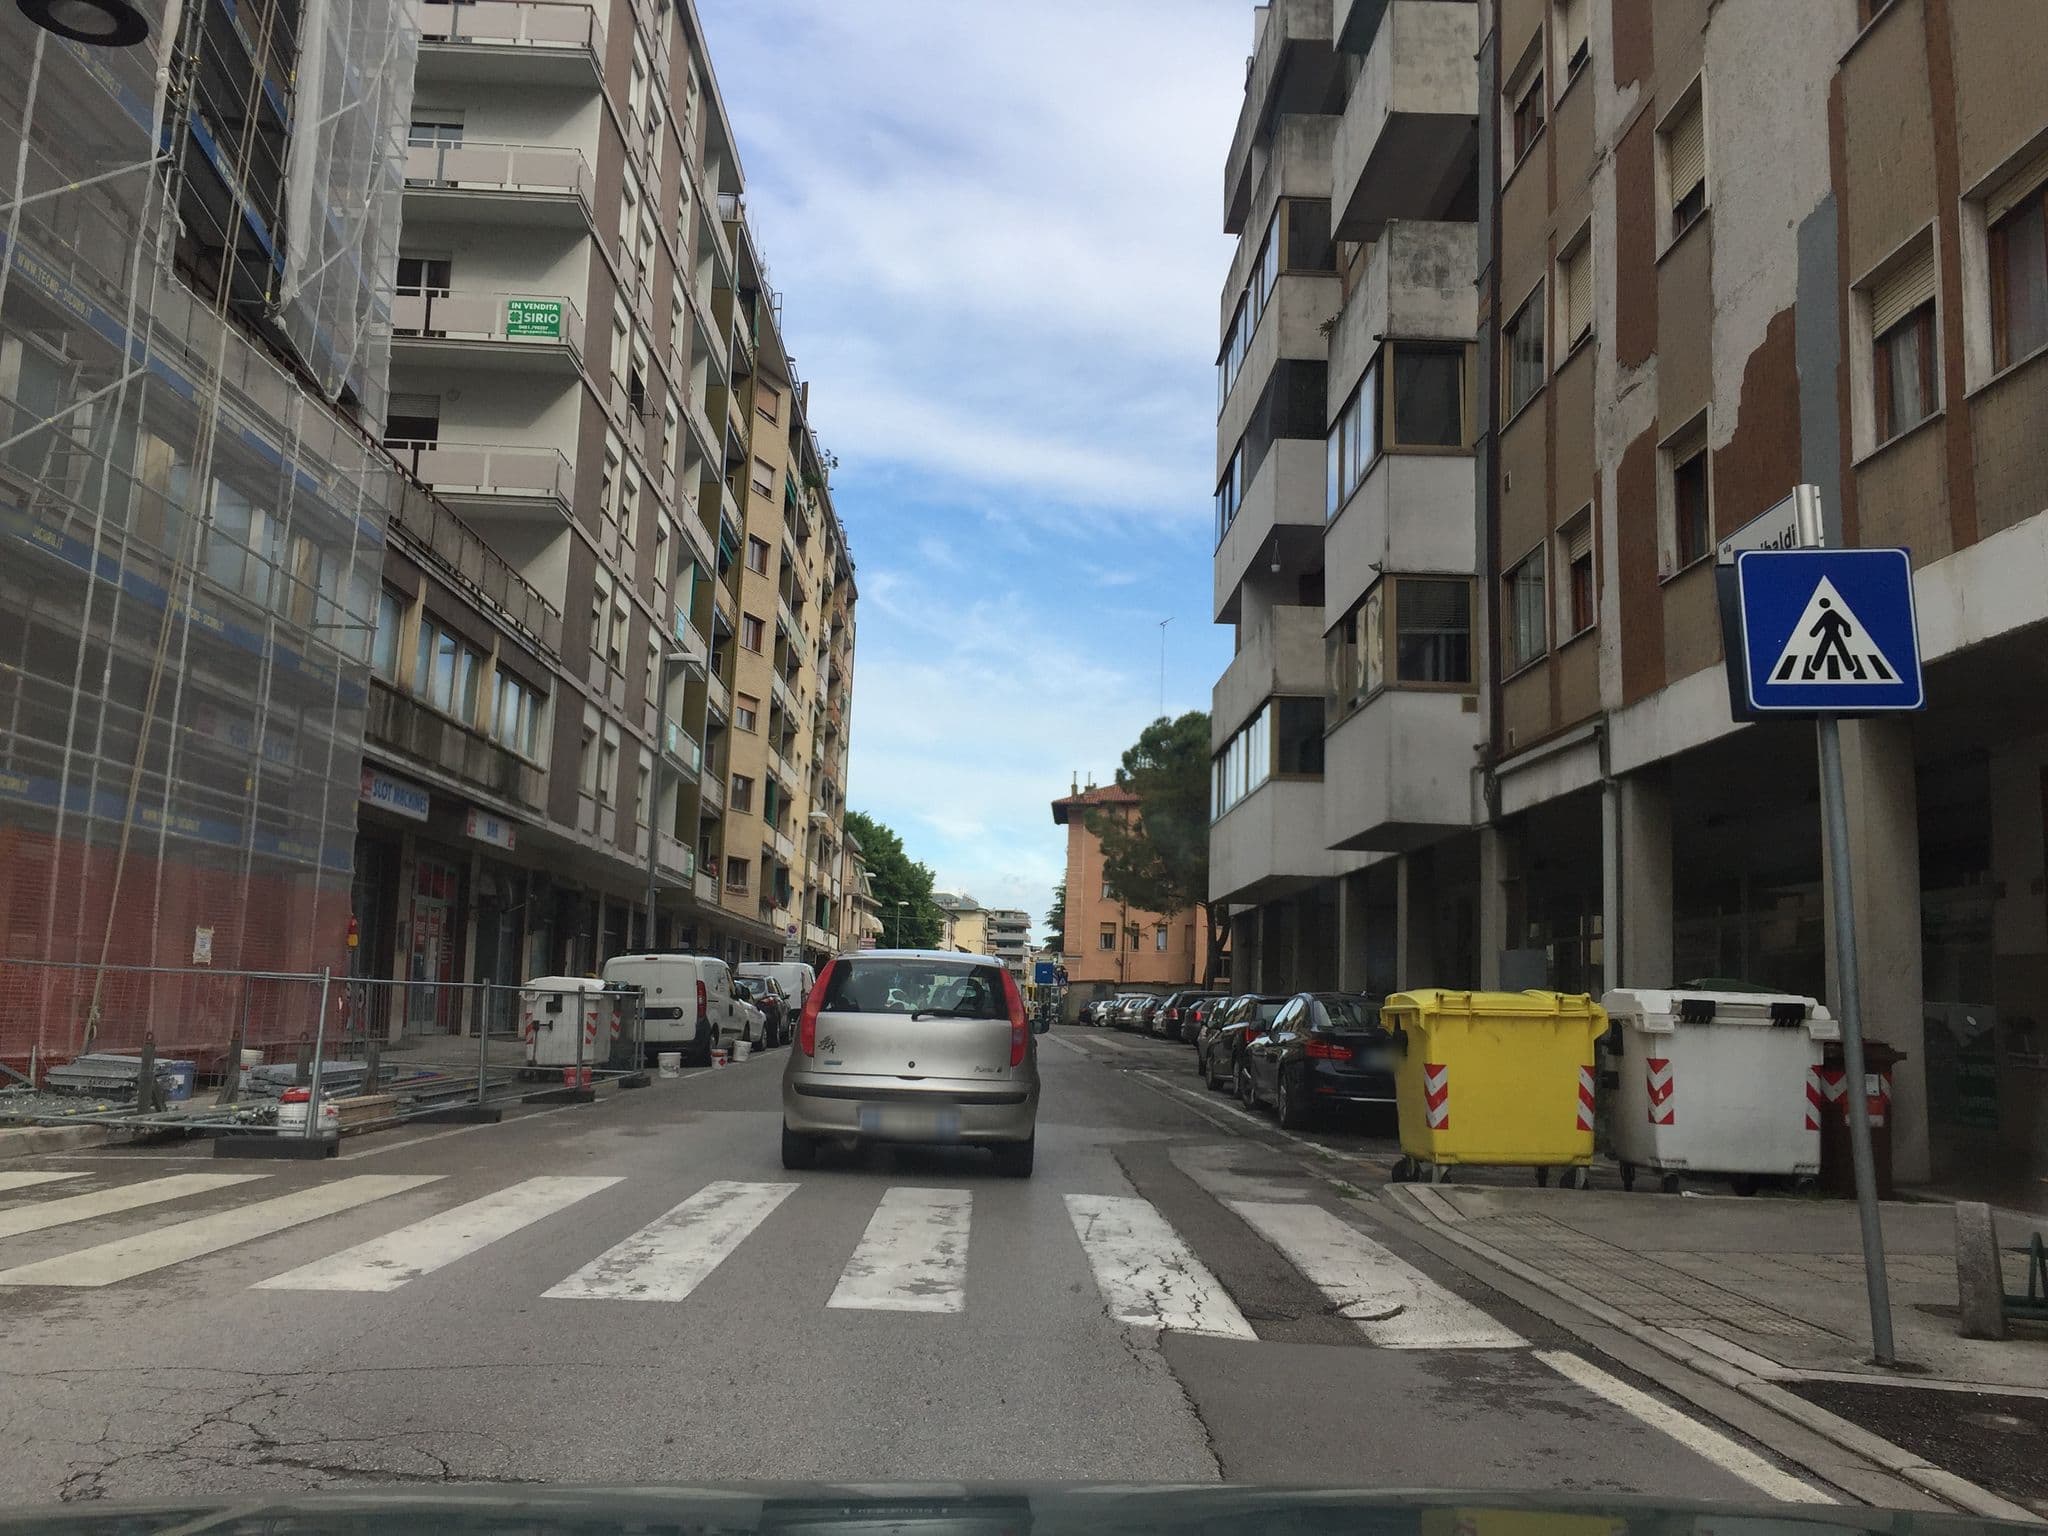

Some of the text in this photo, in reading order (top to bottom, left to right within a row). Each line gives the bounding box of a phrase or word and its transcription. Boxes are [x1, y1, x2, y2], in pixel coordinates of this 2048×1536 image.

[523, 303, 558, 311] VENDITA
[524, 313, 559, 324] SIRIO
[1760, 523, 1796, 549] baldi
[373, 778, 393, 801] SLOT
